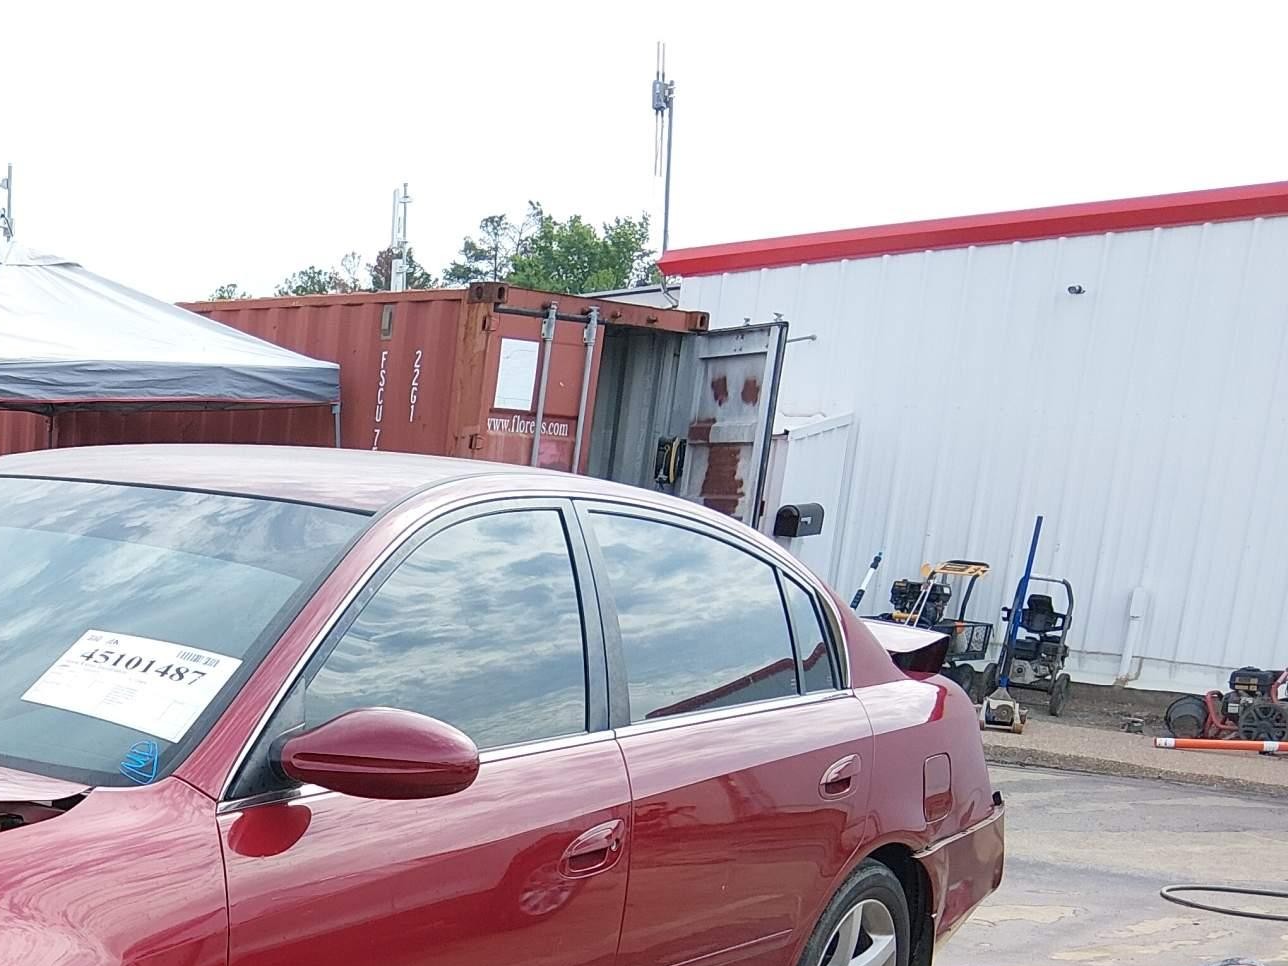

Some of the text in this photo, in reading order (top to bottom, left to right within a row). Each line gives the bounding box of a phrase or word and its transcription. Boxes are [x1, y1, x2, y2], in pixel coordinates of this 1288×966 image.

[374, 350, 389, 423] FSCU
[408, 350, 423, 423] 22G1
[486, 414, 569, 437] www.flores.com
[79, 648, 208, 686] 45101487
